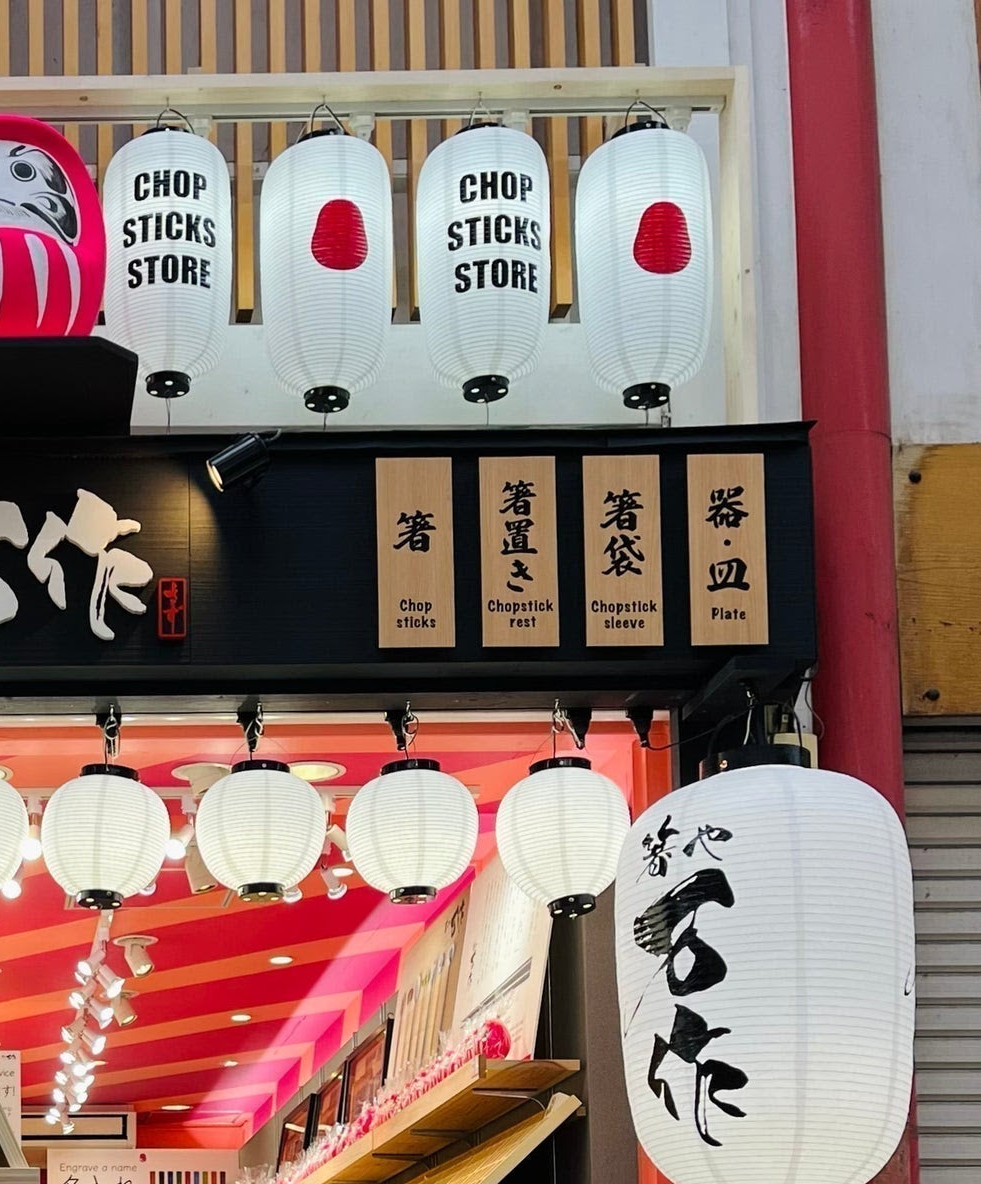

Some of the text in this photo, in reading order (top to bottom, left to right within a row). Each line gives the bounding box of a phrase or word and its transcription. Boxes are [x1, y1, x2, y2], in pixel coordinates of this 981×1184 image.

[133, 169, 207, 202] CHOP
[459, 171, 534, 204] CHOP
[122, 212, 217, 249] STICKS
[447, 216, 542, 252] STICKS
[127, 254, 212, 291] STORE
[455, 257, 539, 294] STORE
[392, 510, 437, 553] 箸
[499, 480, 538, 592] 箸置き
[600, 488, 645, 577] 箸袋
[396, 614, 437, 629] sticks
[399, 598, 433, 613] Chop
[487, 598, 554, 614] Chopstick
[509, 615, 537, 628] rest
[590, 599, 657, 614] Chopstick
[603, 615, 646, 629] sleeve
[711, 607, 746, 621] Plate
[59, 1163, 98, 1173] Engrave
